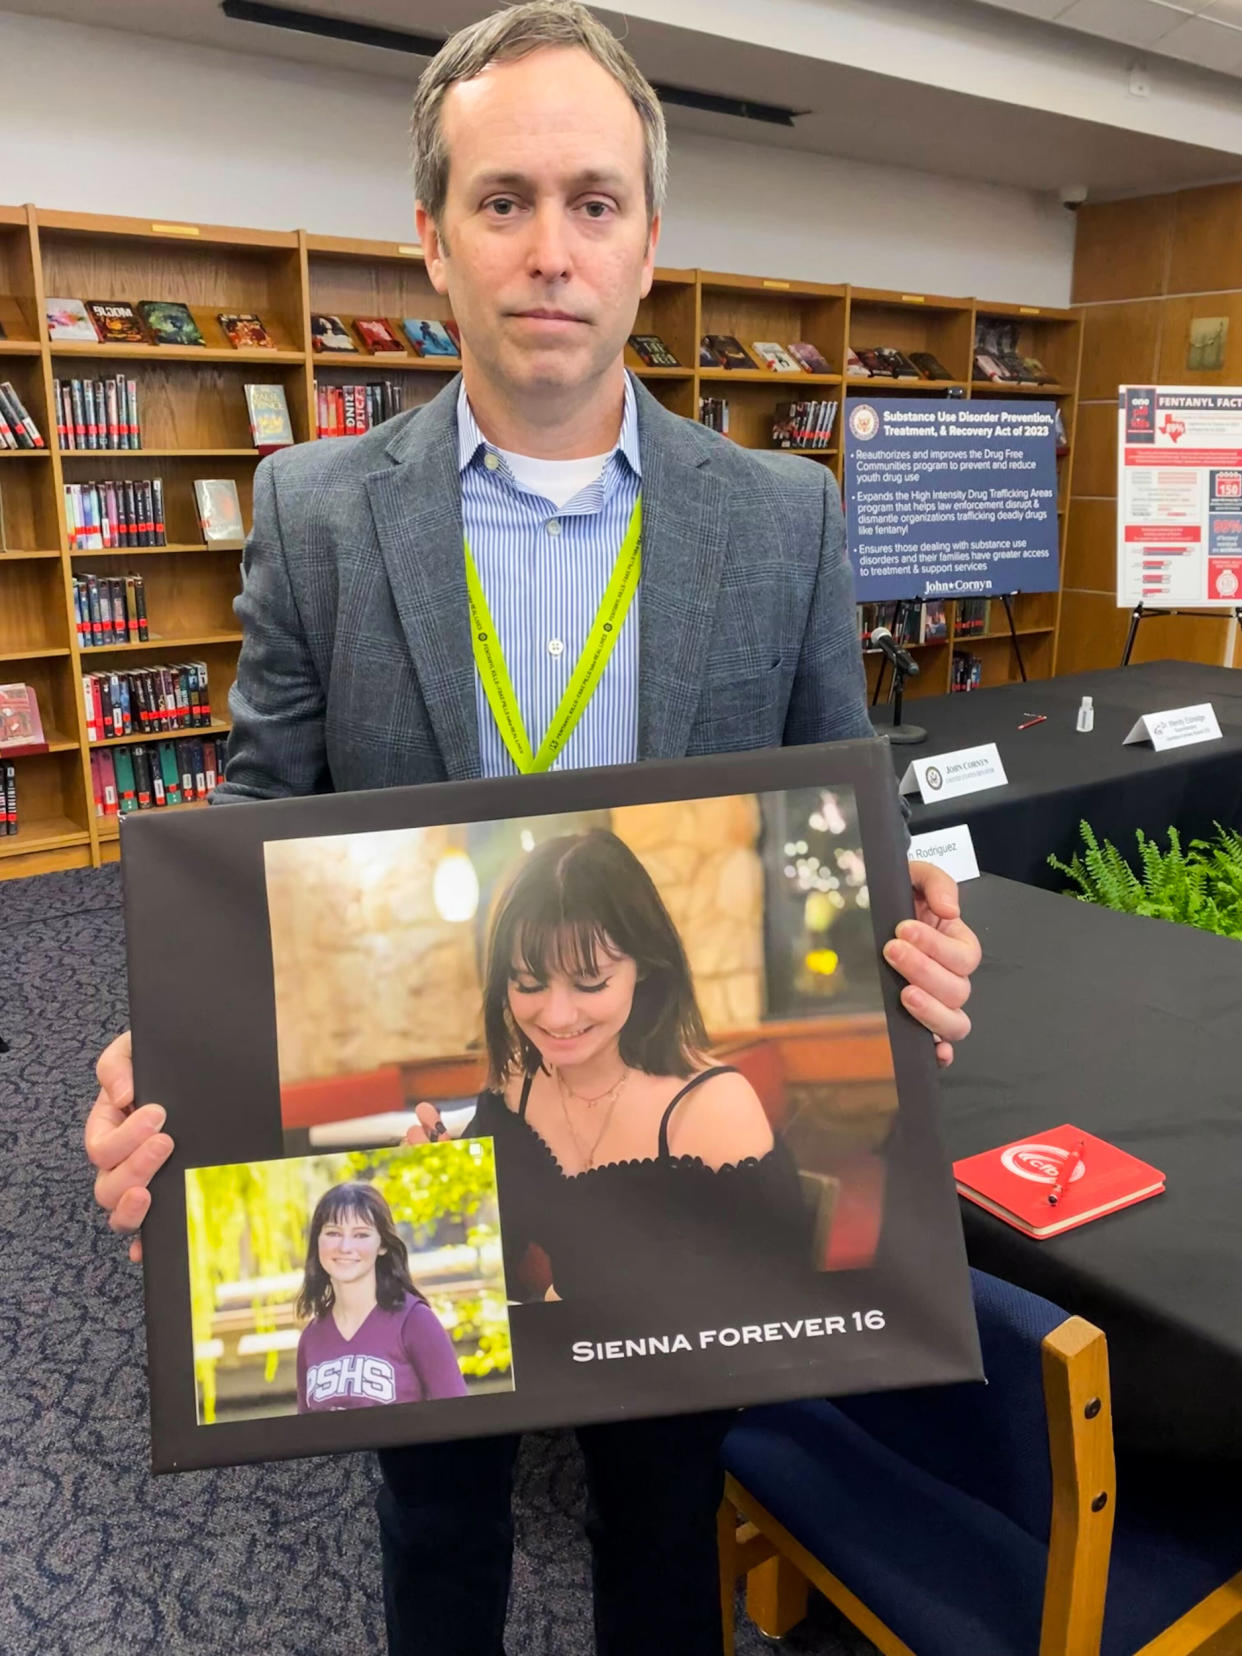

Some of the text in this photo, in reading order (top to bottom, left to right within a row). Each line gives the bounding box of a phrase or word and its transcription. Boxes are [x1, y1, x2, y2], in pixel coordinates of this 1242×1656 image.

[1159, 397, 1214, 407] FENTANYL
[883, 411, 1053, 424] Substance Use Disorder Prevention,
[884, 425, 1049, 438] Treatment, & Recovery Act of 2023
[856, 449, 1023, 461] Reauthorizes and improves the Drug Free
[857, 460, 1036, 472] Communities program to prevent and reduce
[857, 473, 880, 484] youth
[883, 472, 902, 484] drug
[857, 489, 1053, 503] Expands the High Intensity Drug Trafficking Areas
[858, 499, 1039, 514] program that helps law enforcement disrupt &
[858, 510, 1047, 524] dismantle organizations trafficking deadly drugs
[858, 524, 908, 536] like fentanyl
[859, 539, 1026, 554] Ensures those dealing with substance use
[860, 550, 1049, 565] disorders and their families have greater access
[860, 563, 987, 576] to treatment & support services
[925, 580, 992, 594] John Cornyn
[916, 843, 957, 858] Rodriguez
[572, 1310, 886, 1363] SIENNA FOREVER 16
